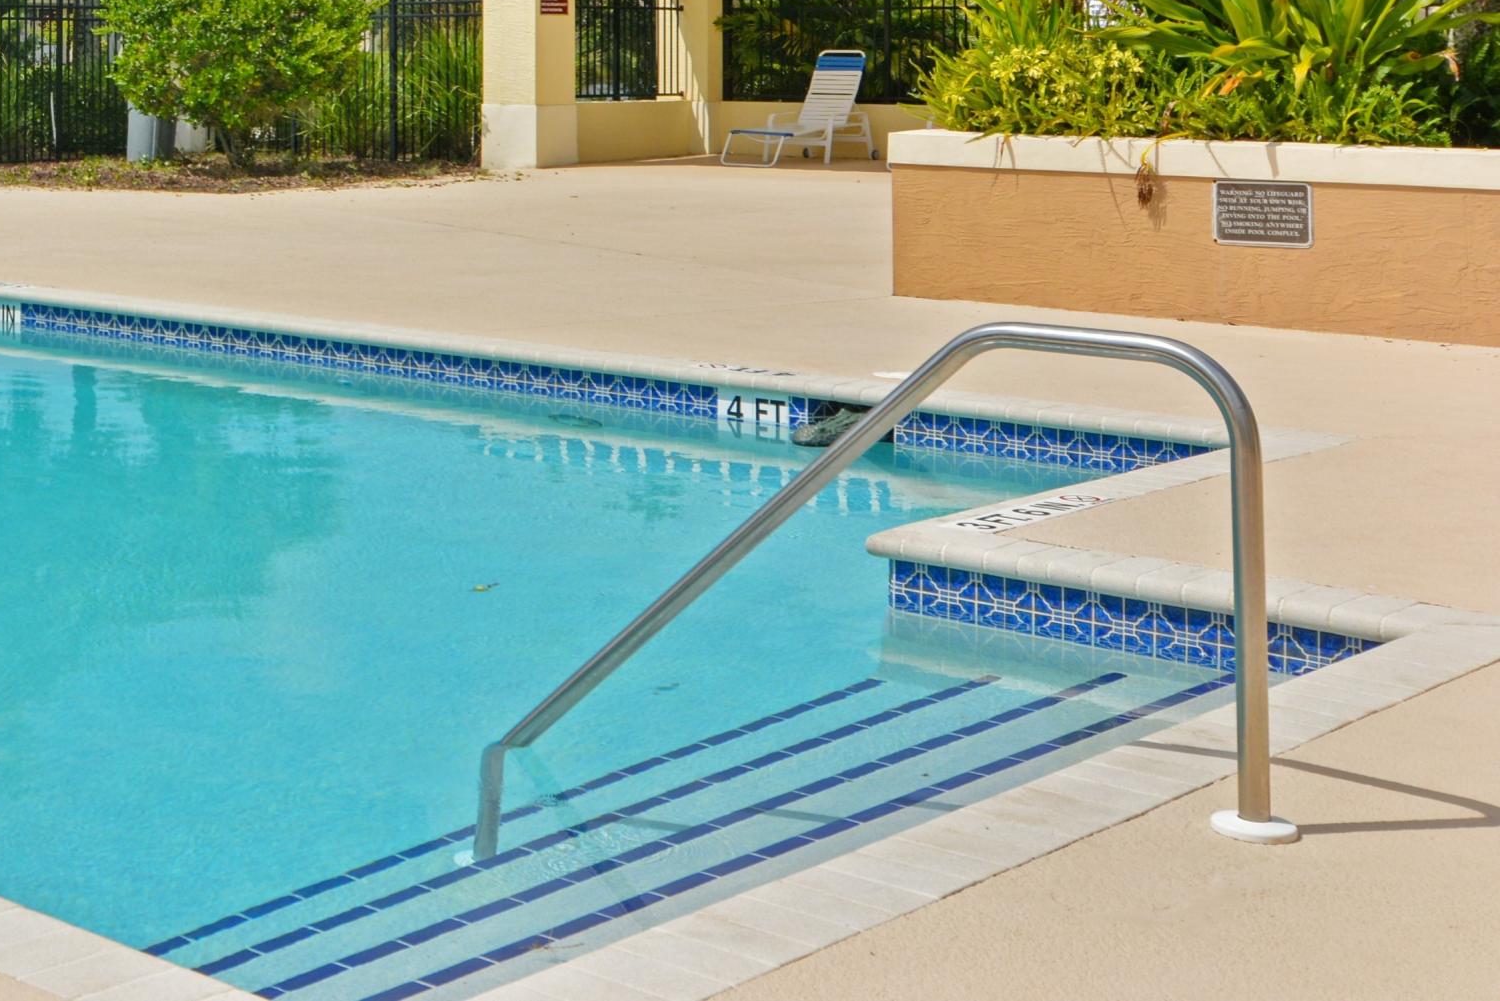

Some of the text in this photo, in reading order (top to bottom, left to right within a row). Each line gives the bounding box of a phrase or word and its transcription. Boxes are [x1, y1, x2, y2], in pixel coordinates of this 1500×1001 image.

[727, 395, 786, 425] 4 FT
[956, 522, 997, 530] 3
[1012, 508, 1051, 516] 6
